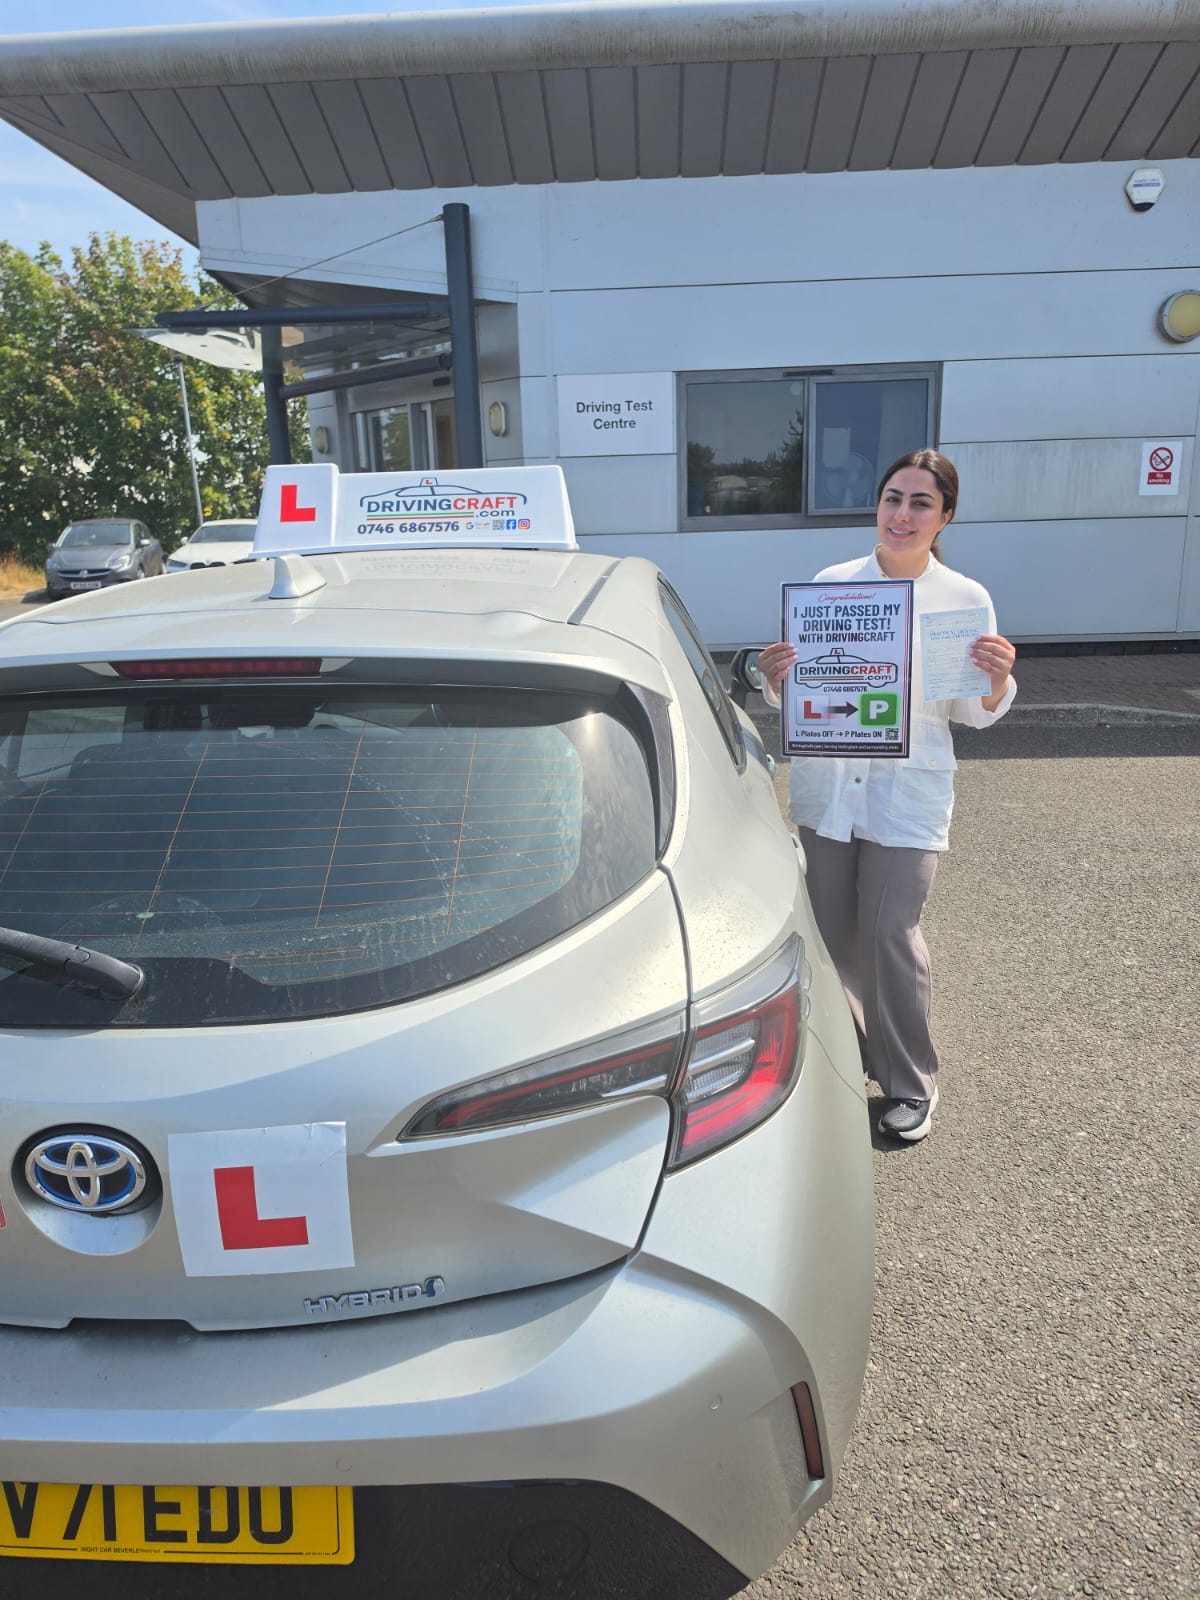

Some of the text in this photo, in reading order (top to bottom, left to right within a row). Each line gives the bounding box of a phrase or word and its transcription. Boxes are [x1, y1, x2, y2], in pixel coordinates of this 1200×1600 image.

[576, 400, 653, 415] Driving Test
[593, 418, 636, 430] Centre
[279, 484, 316, 523] L
[366, 496, 517, 513] DRIVINGCRAFT
[475, 509, 515, 518] .com
[357, 521, 460, 534] 0746 6867576
[794, 603, 901, 619] I JUST PASSED MY
[803, 617, 891, 632] DRIVING TEST!
[798, 631, 896, 644] WITH DRIVINGCRAFT
[799, 665, 893, 676] DRIVINGCRAFT
[804, 700, 822, 719] L
[869, 700, 889, 720] P
[801, 730, 821, 738] Plates
[850, 730, 871, 738] Plates
[873, 730, 882, 738] ON
[213, 1166, 309, 1250] L
[303, 1283, 422, 1315] HYBRID
[142, 1485, 294, 1545] EDU
